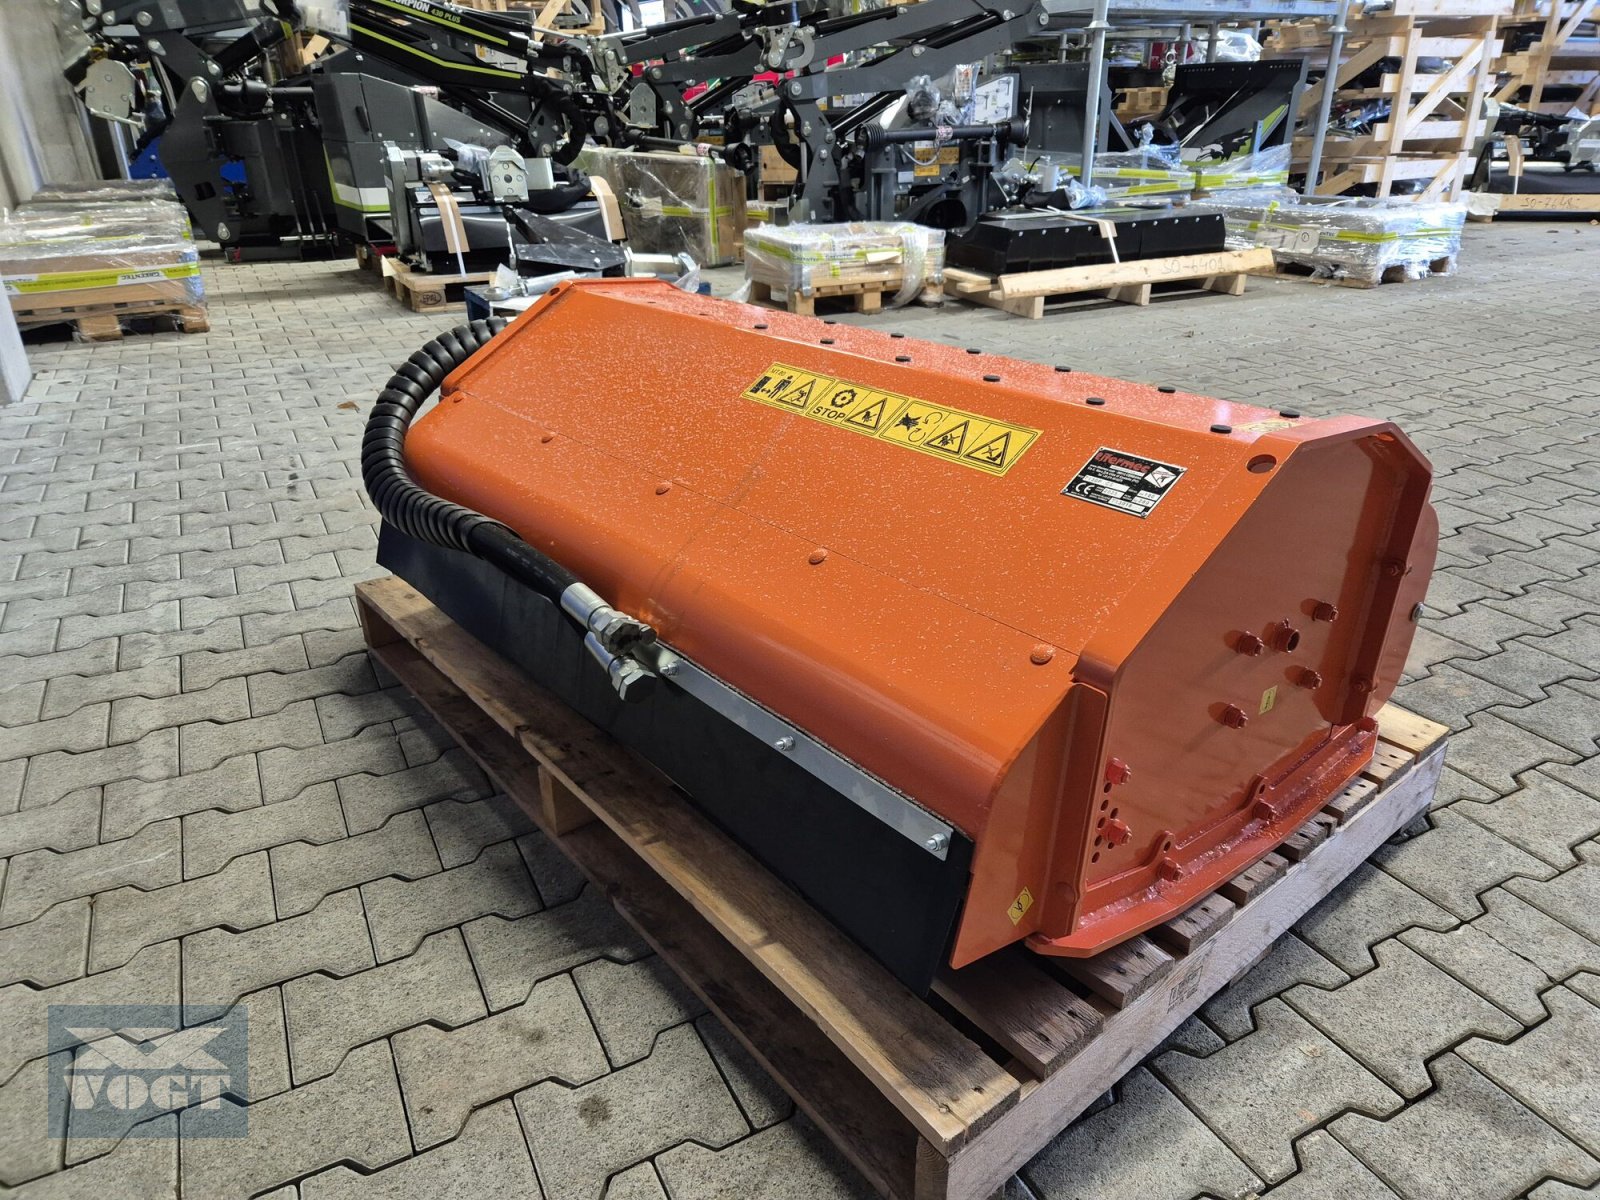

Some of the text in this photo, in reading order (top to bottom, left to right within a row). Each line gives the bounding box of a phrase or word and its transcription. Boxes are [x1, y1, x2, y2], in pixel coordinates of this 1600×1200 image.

[431, 8, 444, 18] 430
[444, 13, 461, 23] PLUS
[813, 406, 846, 420] STOP
[1076, 482, 1094, 494] CE
